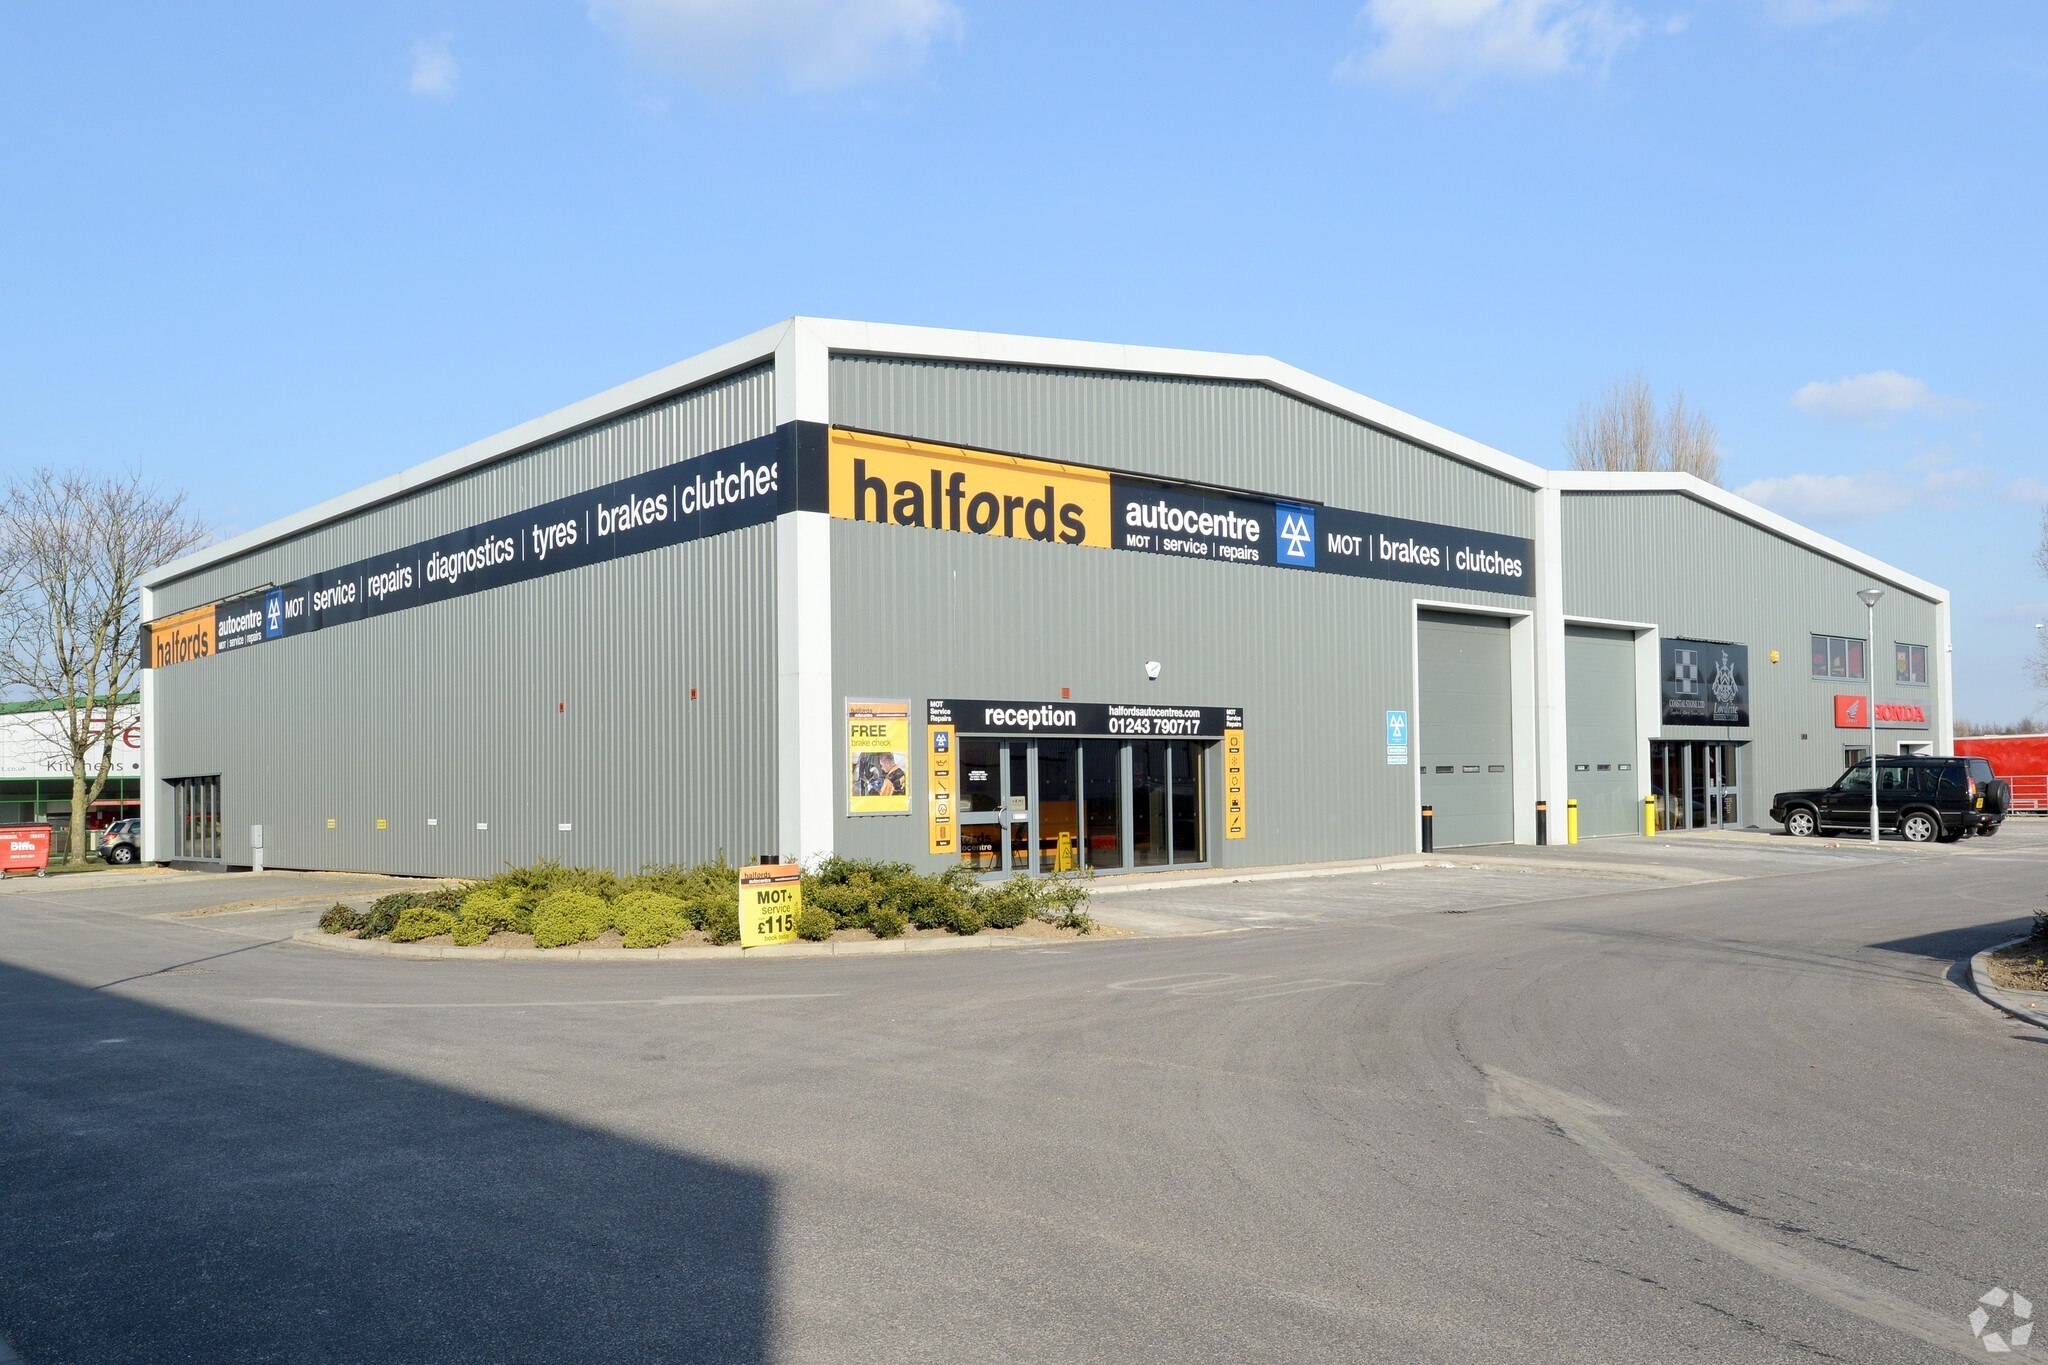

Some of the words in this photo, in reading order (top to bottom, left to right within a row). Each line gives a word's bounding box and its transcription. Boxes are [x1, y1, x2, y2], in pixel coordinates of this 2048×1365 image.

[854, 458, 1086, 546] halfords
[1125, 500, 1260, 542] autocentre
[285, 597, 304, 619] MOT
[313, 579, 355, 612] service
[368, 563, 412, 601] repairs
[426, 535, 514, 584] diagnostics
[532, 518, 577, 560] tyres
[598, 494, 668, 537] brakes
[681, 461, 777, 515] clutches
[1126, 534, 1150, 548] MOT
[1163, 537, 1208, 555] service
[1219, 544, 1259, 562] repairs
[1328, 532, 1362, 556] MOT
[1379, 534, 1440, 567] brakes
[1455, 546, 1522, 578] clutches
[218, 609, 262, 637] autocentre
[156, 624, 208, 668] halfords
[218, 640, 227, 650] MOT
[229, 634, 244, 648] service
[246, 630, 262, 645] repairs
[930, 715, 952, 723] Repairs
[985, 705, 1076, 730] reception
[1108, 705, 1200, 718] halfordsautocentres.com
[851, 724, 887, 738] FREE
[1108, 717, 1150, 734] 01243
[1153, 719, 1200, 735] 790717
[1226, 721, 1242, 729] Repairs
[851, 739, 870, 747] brake
[871, 739, 891, 747] check
[0, 764, 27, 772] t.co.uk
[11, 841, 36, 851] Biffa
[744, 871, 772, 880] halfords
[761, 904, 791, 914] service
[758, 914, 793, 935] £115
